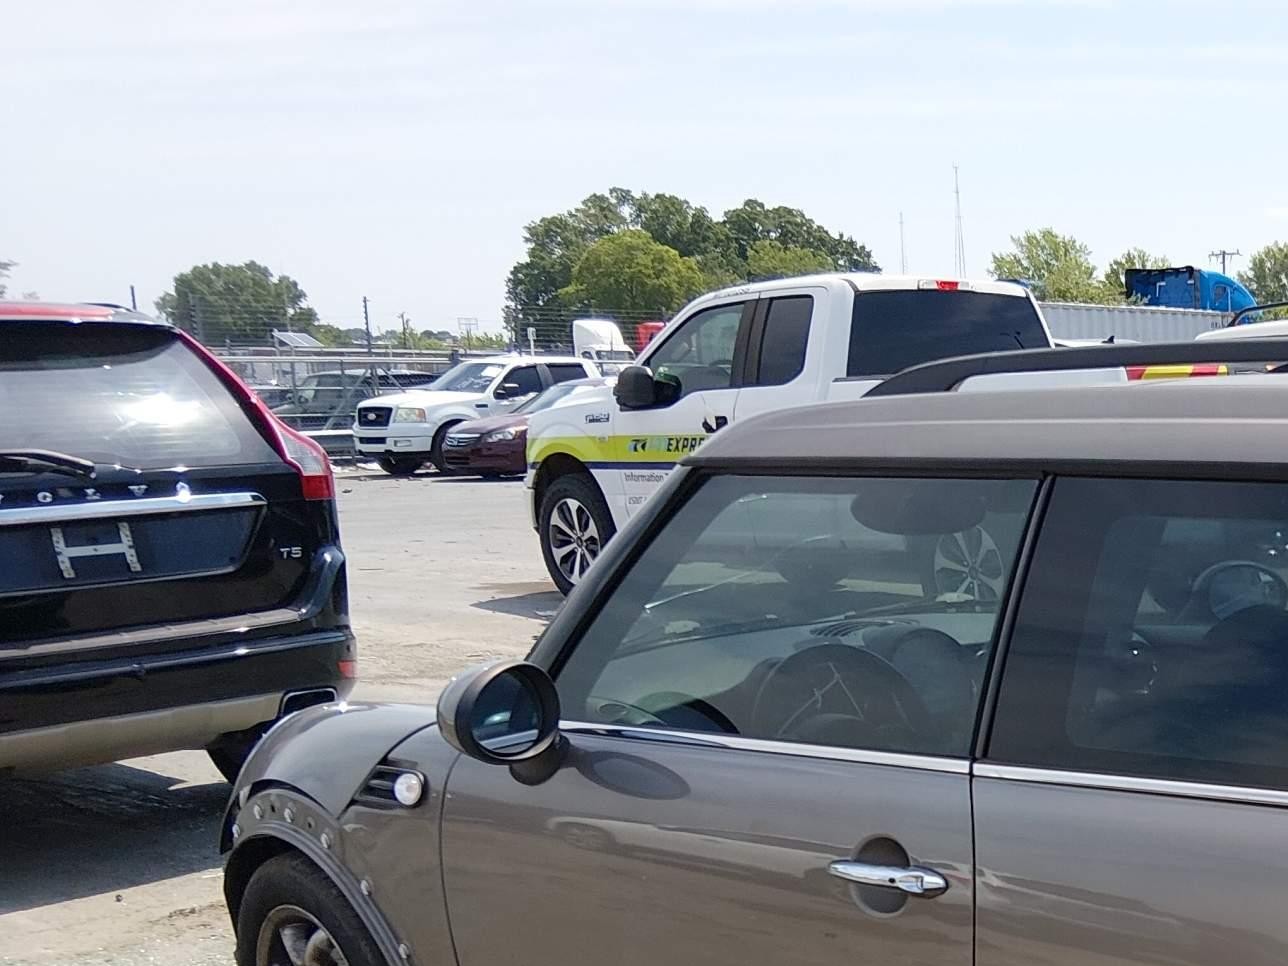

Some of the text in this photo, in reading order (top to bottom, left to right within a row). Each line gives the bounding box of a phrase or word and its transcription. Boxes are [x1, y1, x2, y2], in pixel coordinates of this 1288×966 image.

[624, 471, 664, 482] Information
[0, 481, 192, 502] OLVO
[280, 546, 302, 559] T5
